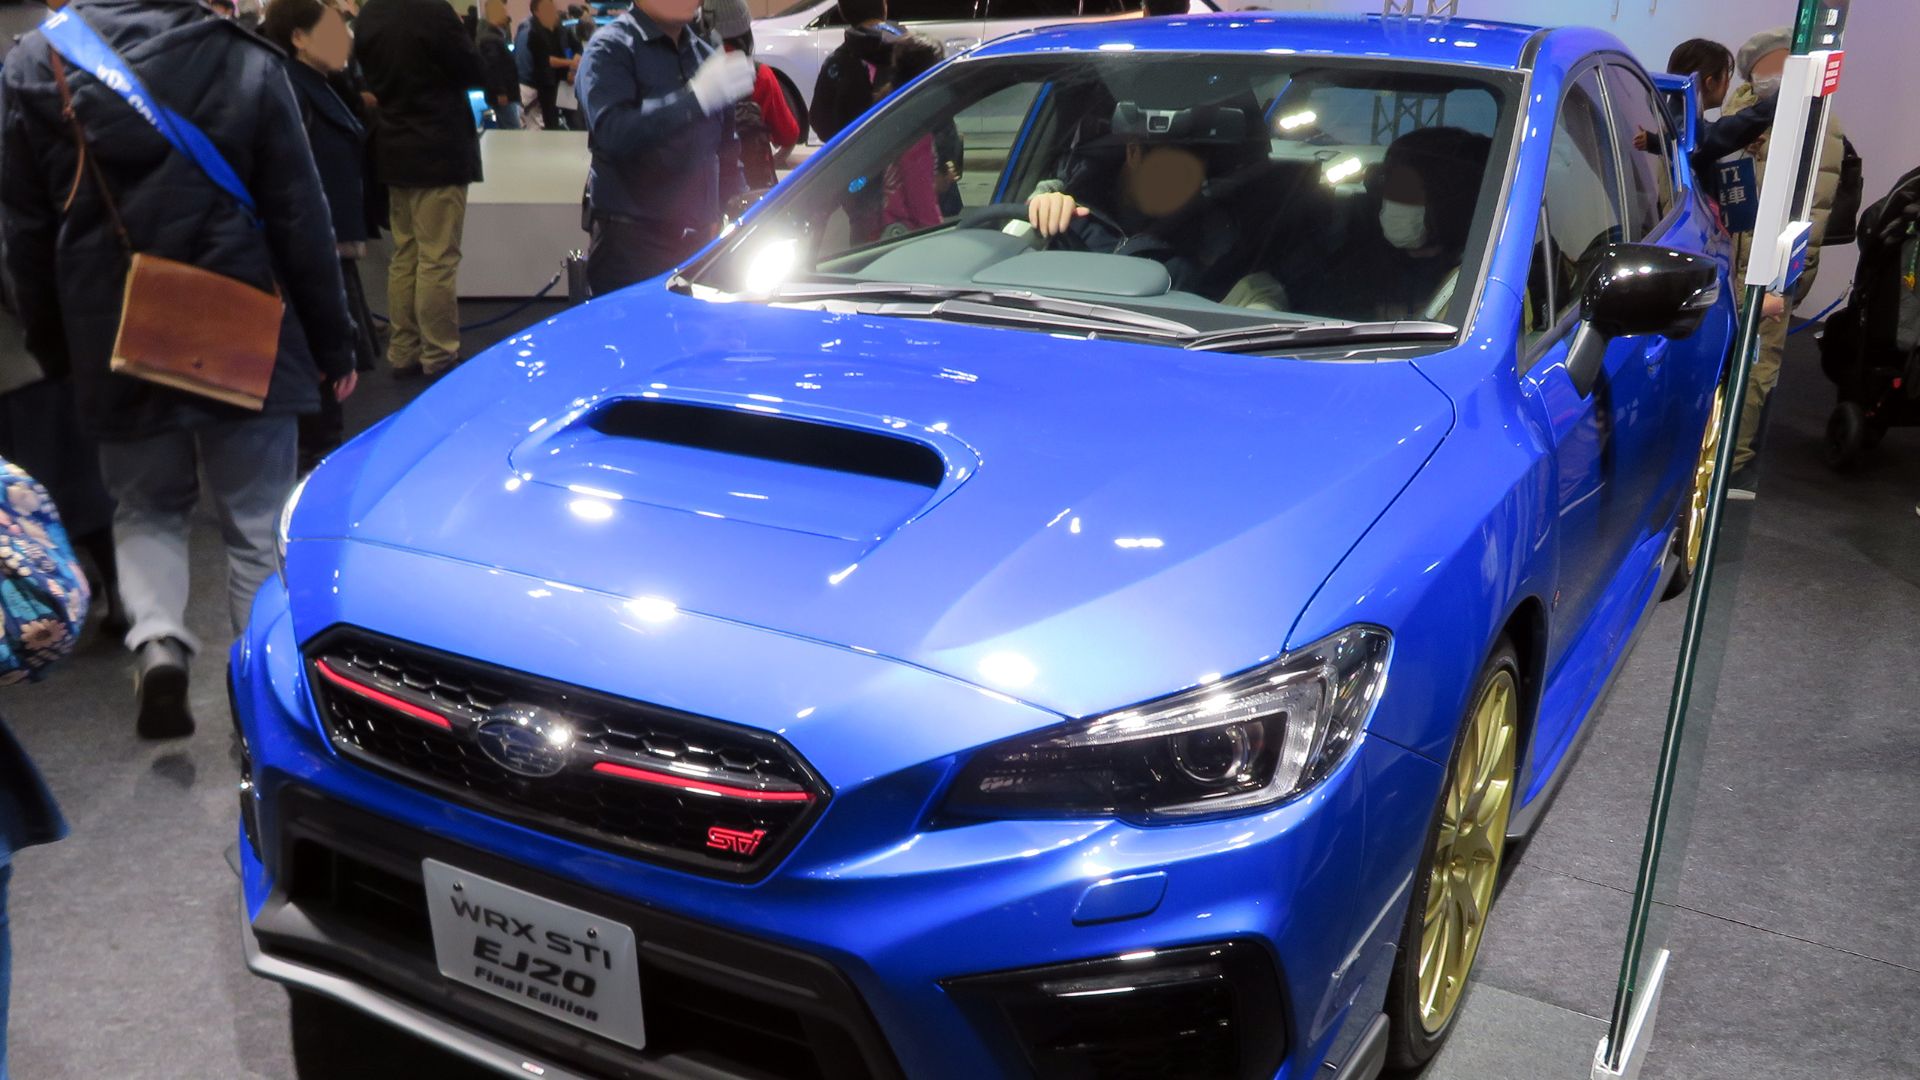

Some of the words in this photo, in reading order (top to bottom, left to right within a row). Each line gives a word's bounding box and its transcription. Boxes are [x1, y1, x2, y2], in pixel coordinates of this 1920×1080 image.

[450, 895, 537, 944] WRX
[544, 929, 613, 971] STI
[472, 935, 597, 998] EJ20
[473, 965, 523, 994] Final
[526, 984, 599, 1023] Edition
